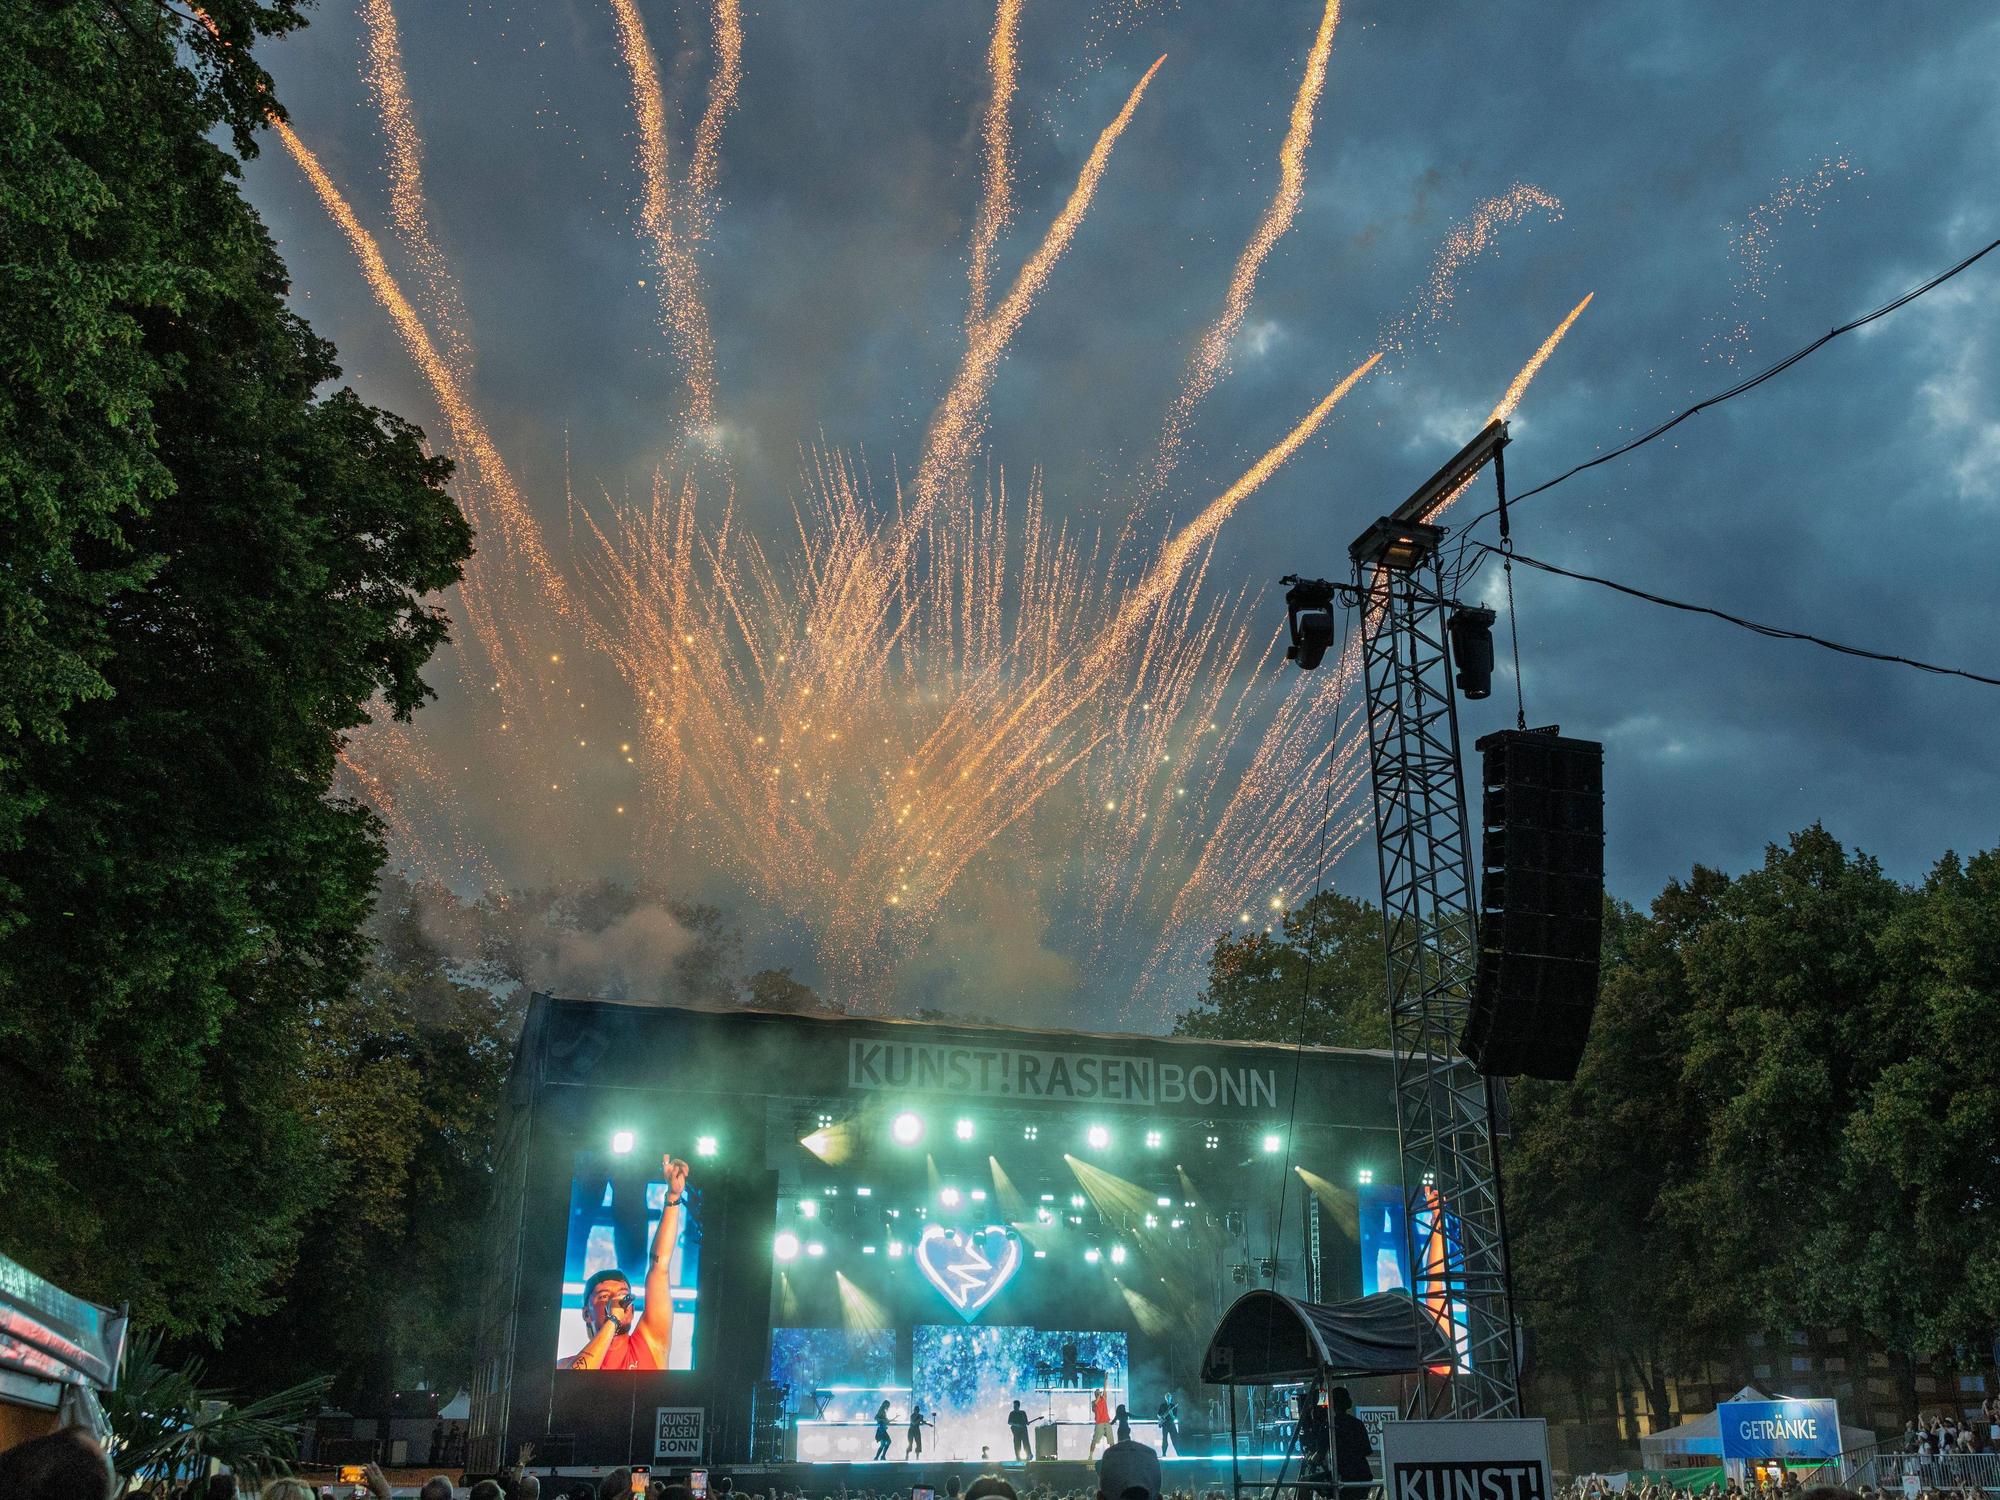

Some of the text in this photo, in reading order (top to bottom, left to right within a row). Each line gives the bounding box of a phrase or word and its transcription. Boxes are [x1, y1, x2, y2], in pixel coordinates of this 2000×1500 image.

[1159, 1062, 1278, 1108] BONN
[661, 1413, 700, 1425] KUNST!
[1361, 1412, 1395, 1422] KUNST!
[662, 1426, 697, 1438] RASEN
[1740, 1414, 1818, 1440] GETRÄNKE
[660, 1440, 698, 1452] BONN
[1399, 1467, 1538, 1500] KUNST!
